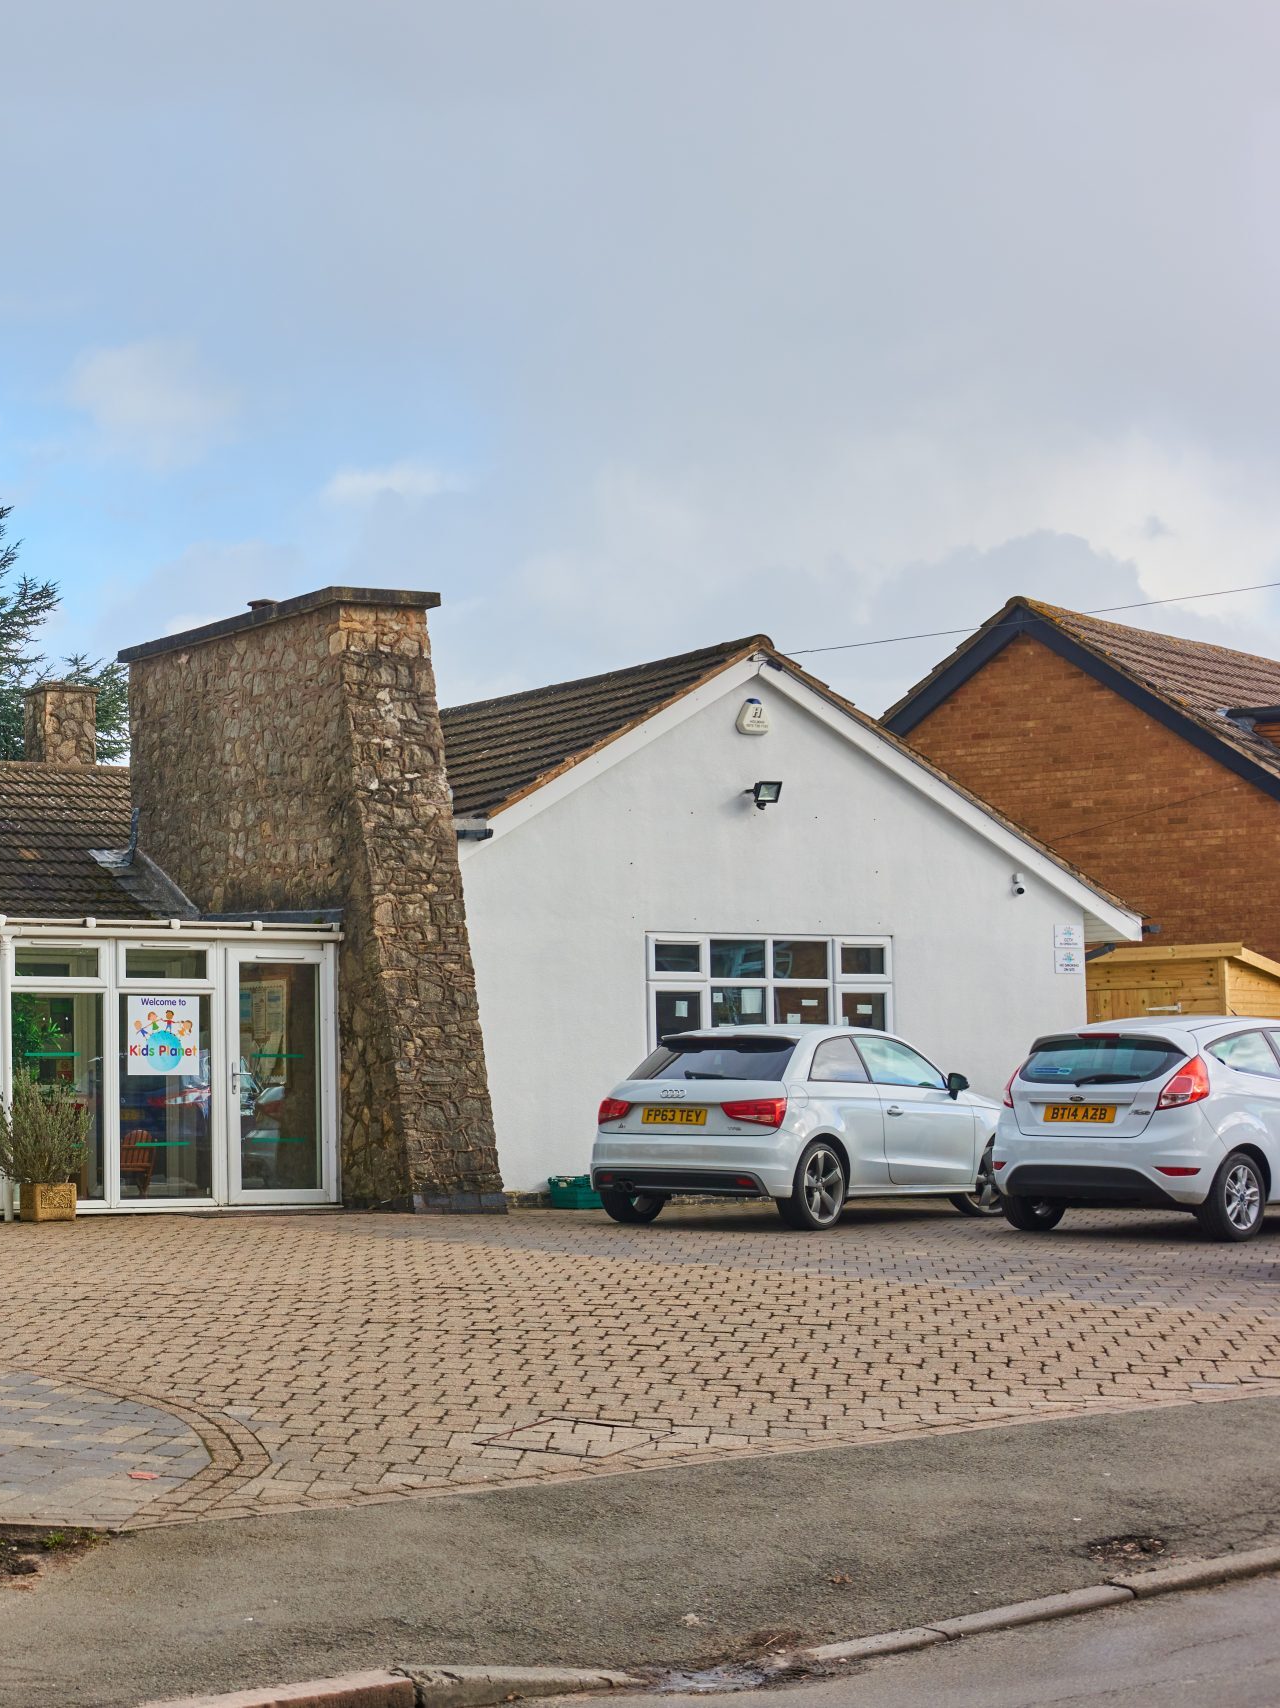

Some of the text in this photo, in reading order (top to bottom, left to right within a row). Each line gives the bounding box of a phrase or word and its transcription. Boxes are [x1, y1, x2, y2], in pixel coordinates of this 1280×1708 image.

[141, 998, 187, 1006] Welcome to
[129, 1044, 197, 1056] Kids Planet
[646, 1109, 702, 1123] FP63 TEY
[1051, 1107, 1107, 1120] BT14 AZB
